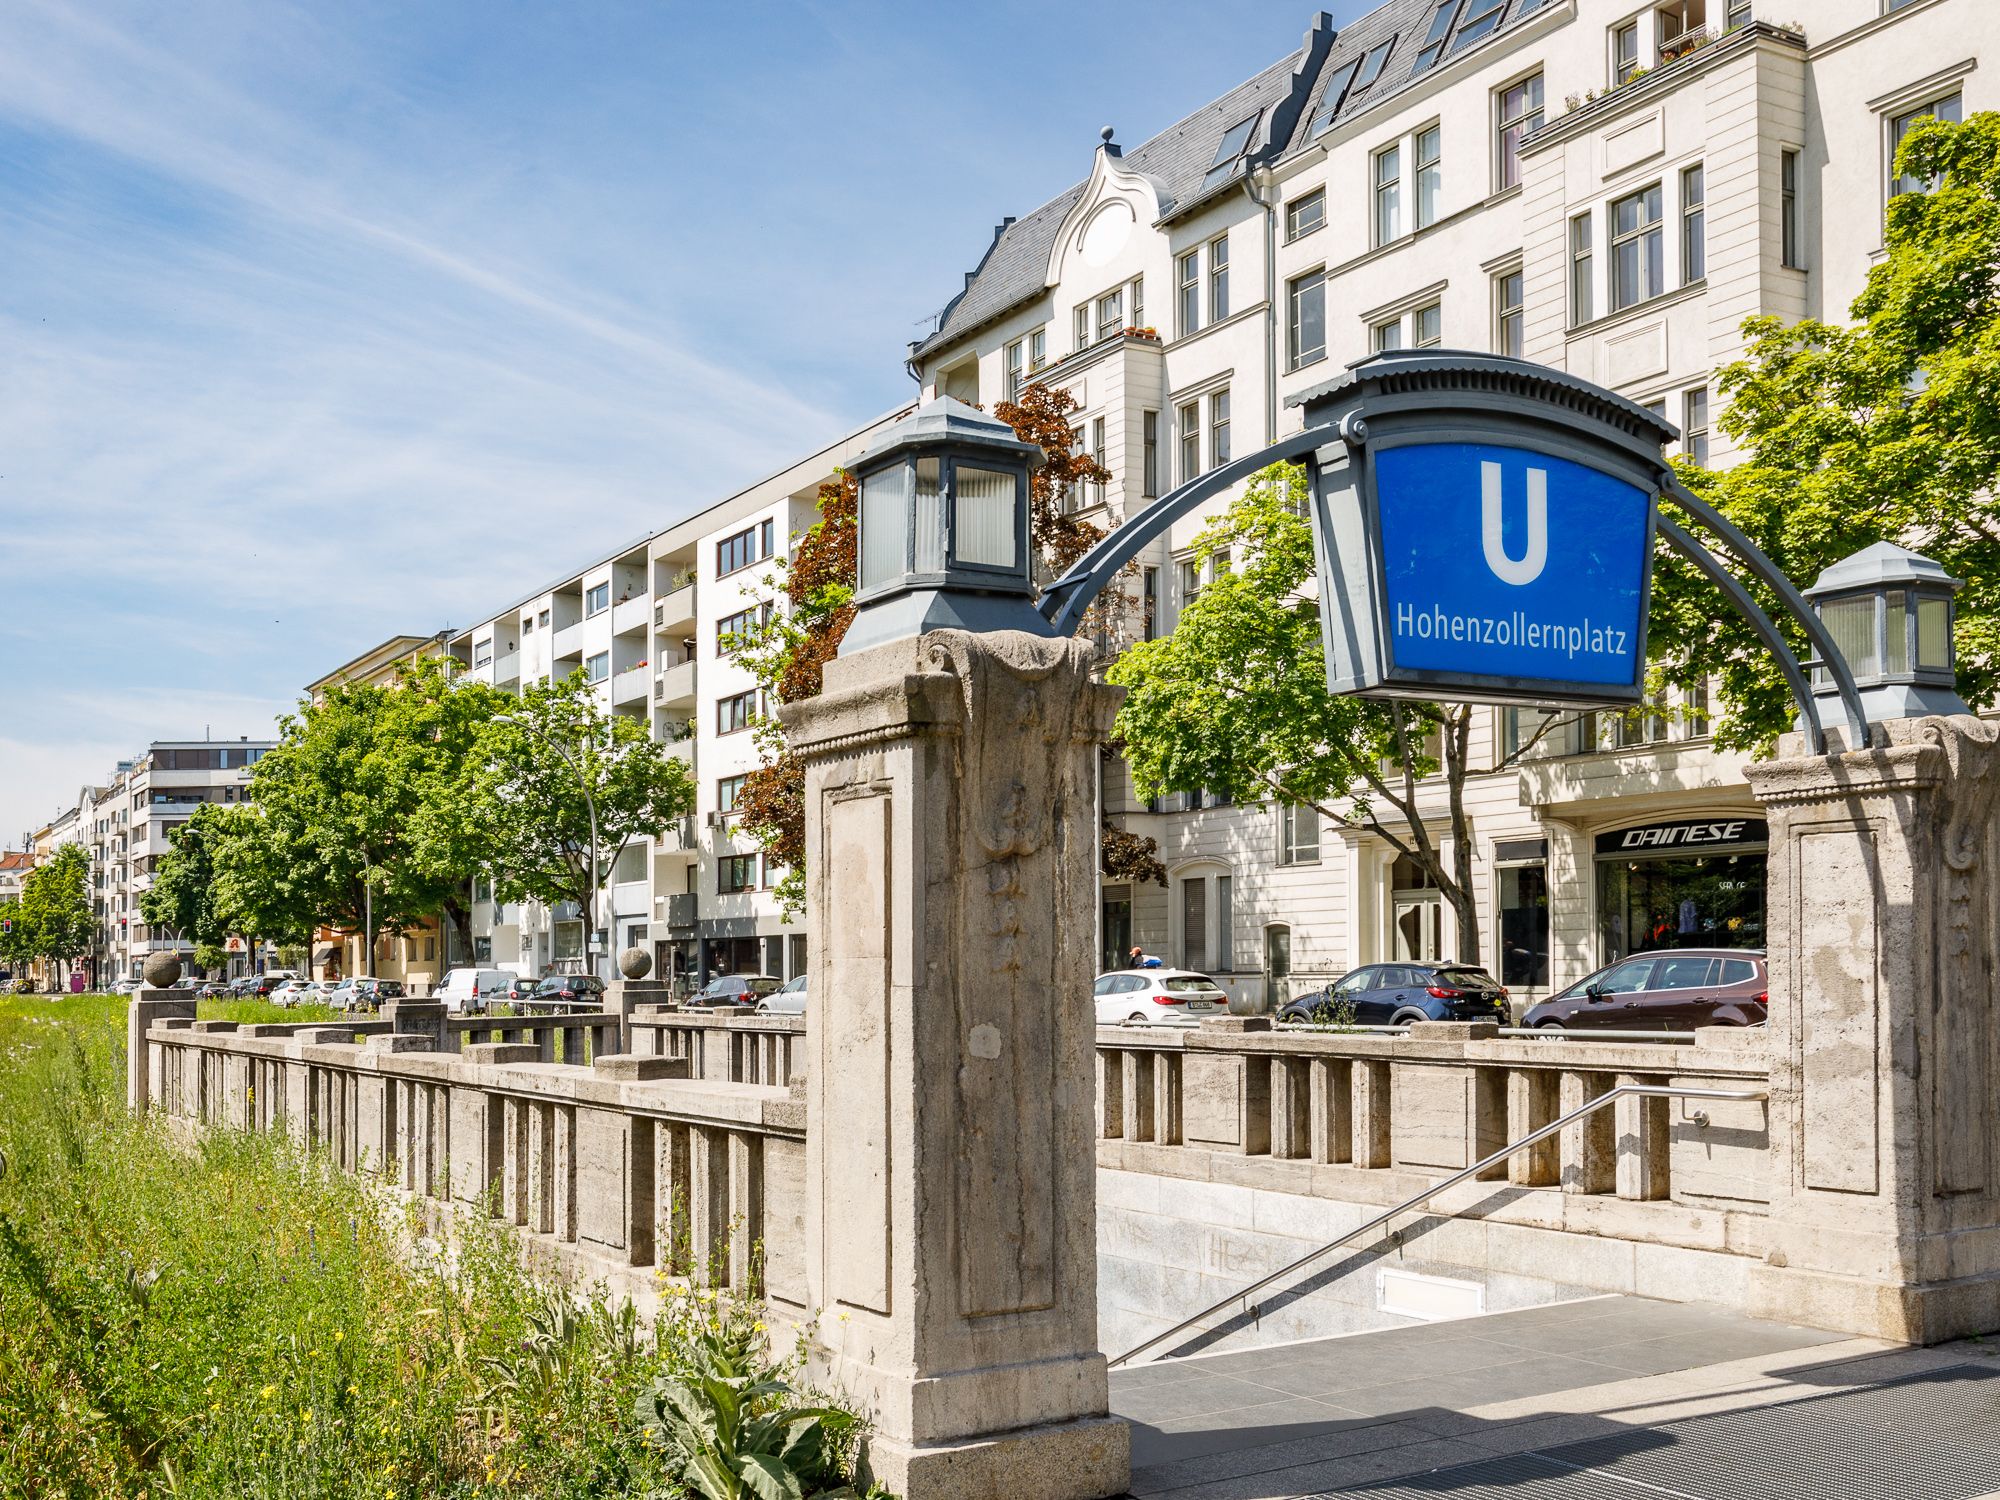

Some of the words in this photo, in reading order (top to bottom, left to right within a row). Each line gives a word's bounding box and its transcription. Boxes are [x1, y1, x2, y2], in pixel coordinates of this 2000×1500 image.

[1481, 460, 1548, 586] U
[1397, 602, 1627, 659] Hohenzollernplatz
[1621, 821, 1747, 847] DAINESE
